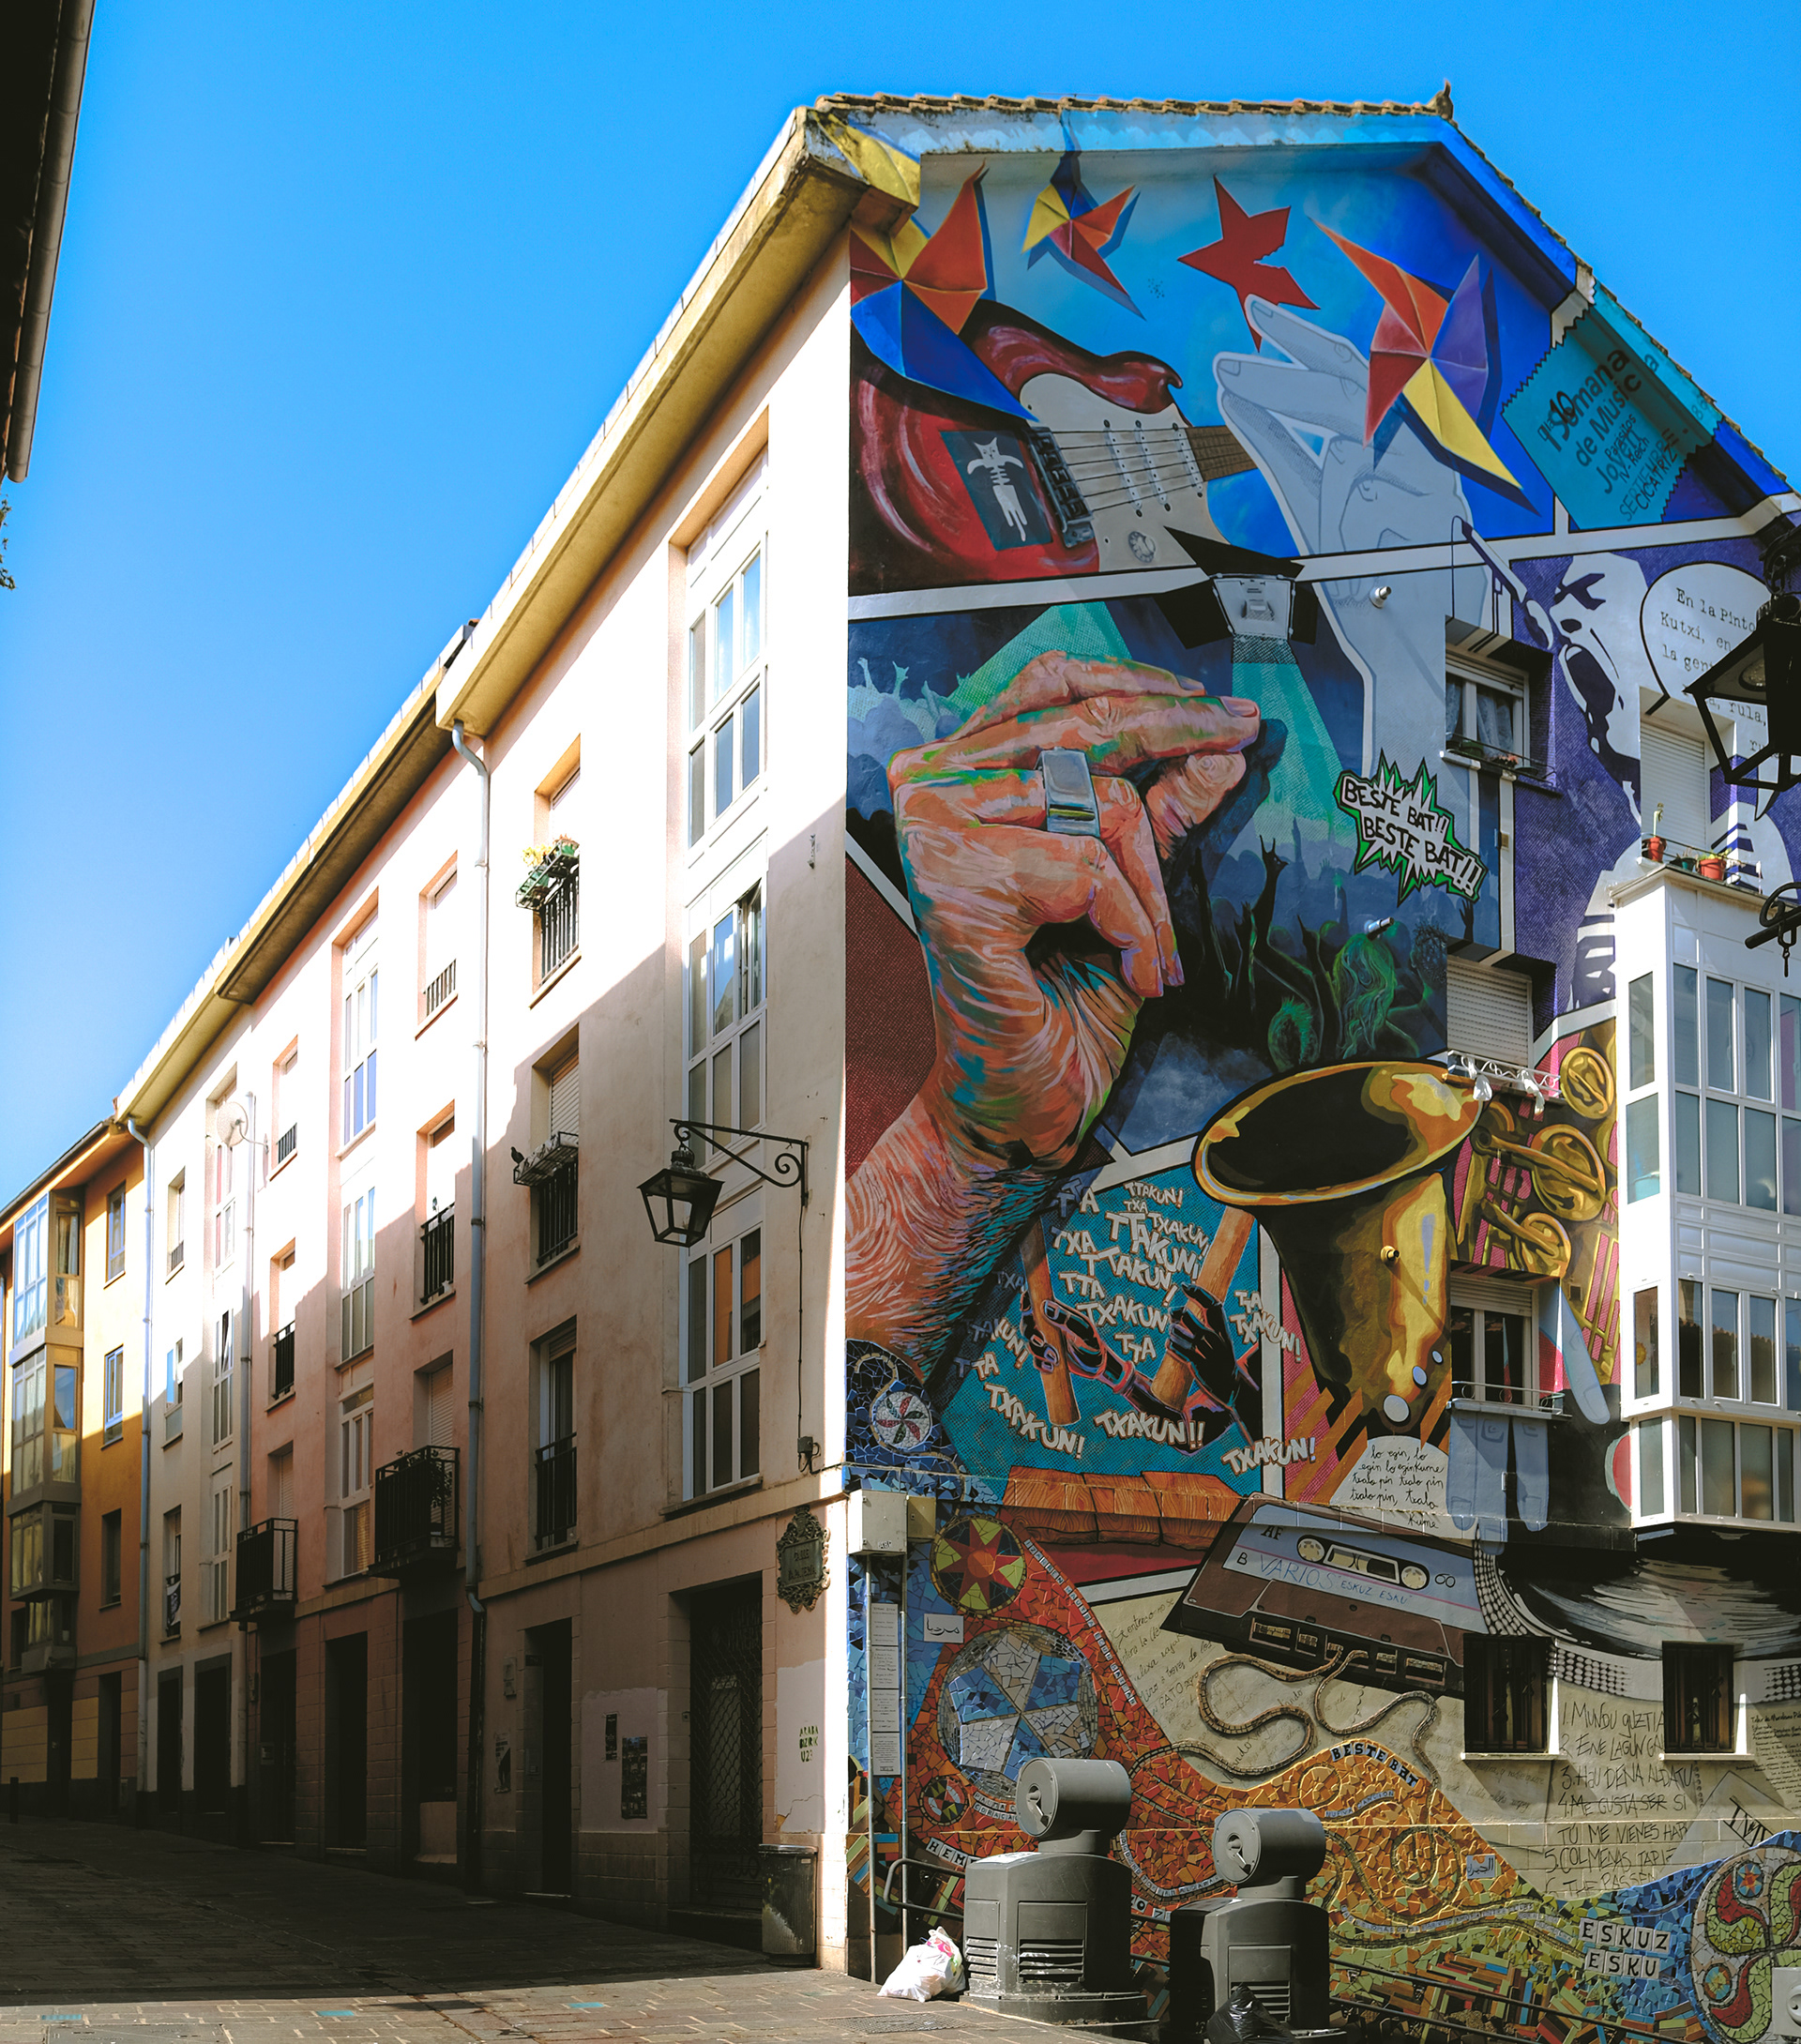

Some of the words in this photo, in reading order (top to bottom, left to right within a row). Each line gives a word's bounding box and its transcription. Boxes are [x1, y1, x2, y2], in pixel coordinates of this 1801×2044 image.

[1676, 587, 1694, 608] En
[1700, 599, 1716, 617] la
[1662, 643, 1677, 661] la
[1345, 779, 1400, 817] BESTE
[1407, 806, 1447, 834] BAT!!
[1364, 815, 1419, 859] BESTE
[1425, 840, 1482, 891] BAT!!
[1125, 1181, 1184, 1208] TTAKUN!
[1058, 1272, 1106, 1301] TTA
[1114, 1333, 1158, 1364] TTA
[985, 1382, 1085, 1460] TXAKUN!
[1094, 1410, 1205, 1449] TXAKUN!!
[1221, 1437, 1316, 1476] TXAKUN!
[1370, 1445, 1384, 1460] lo
[1236, 1552, 1248, 1566] B
[1260, 1553, 1336, 1590] VARIOS
[1332, 1743, 1386, 1762] BESTE
[1389, 1759, 1418, 1787] BAT
[1588, 1824, 1611, 1843] ME
[929, 1840, 976, 1867] HEM
[1582, 1922, 1669, 1950] ESKUZ
[1589, 1953, 1657, 1977] ESKU
